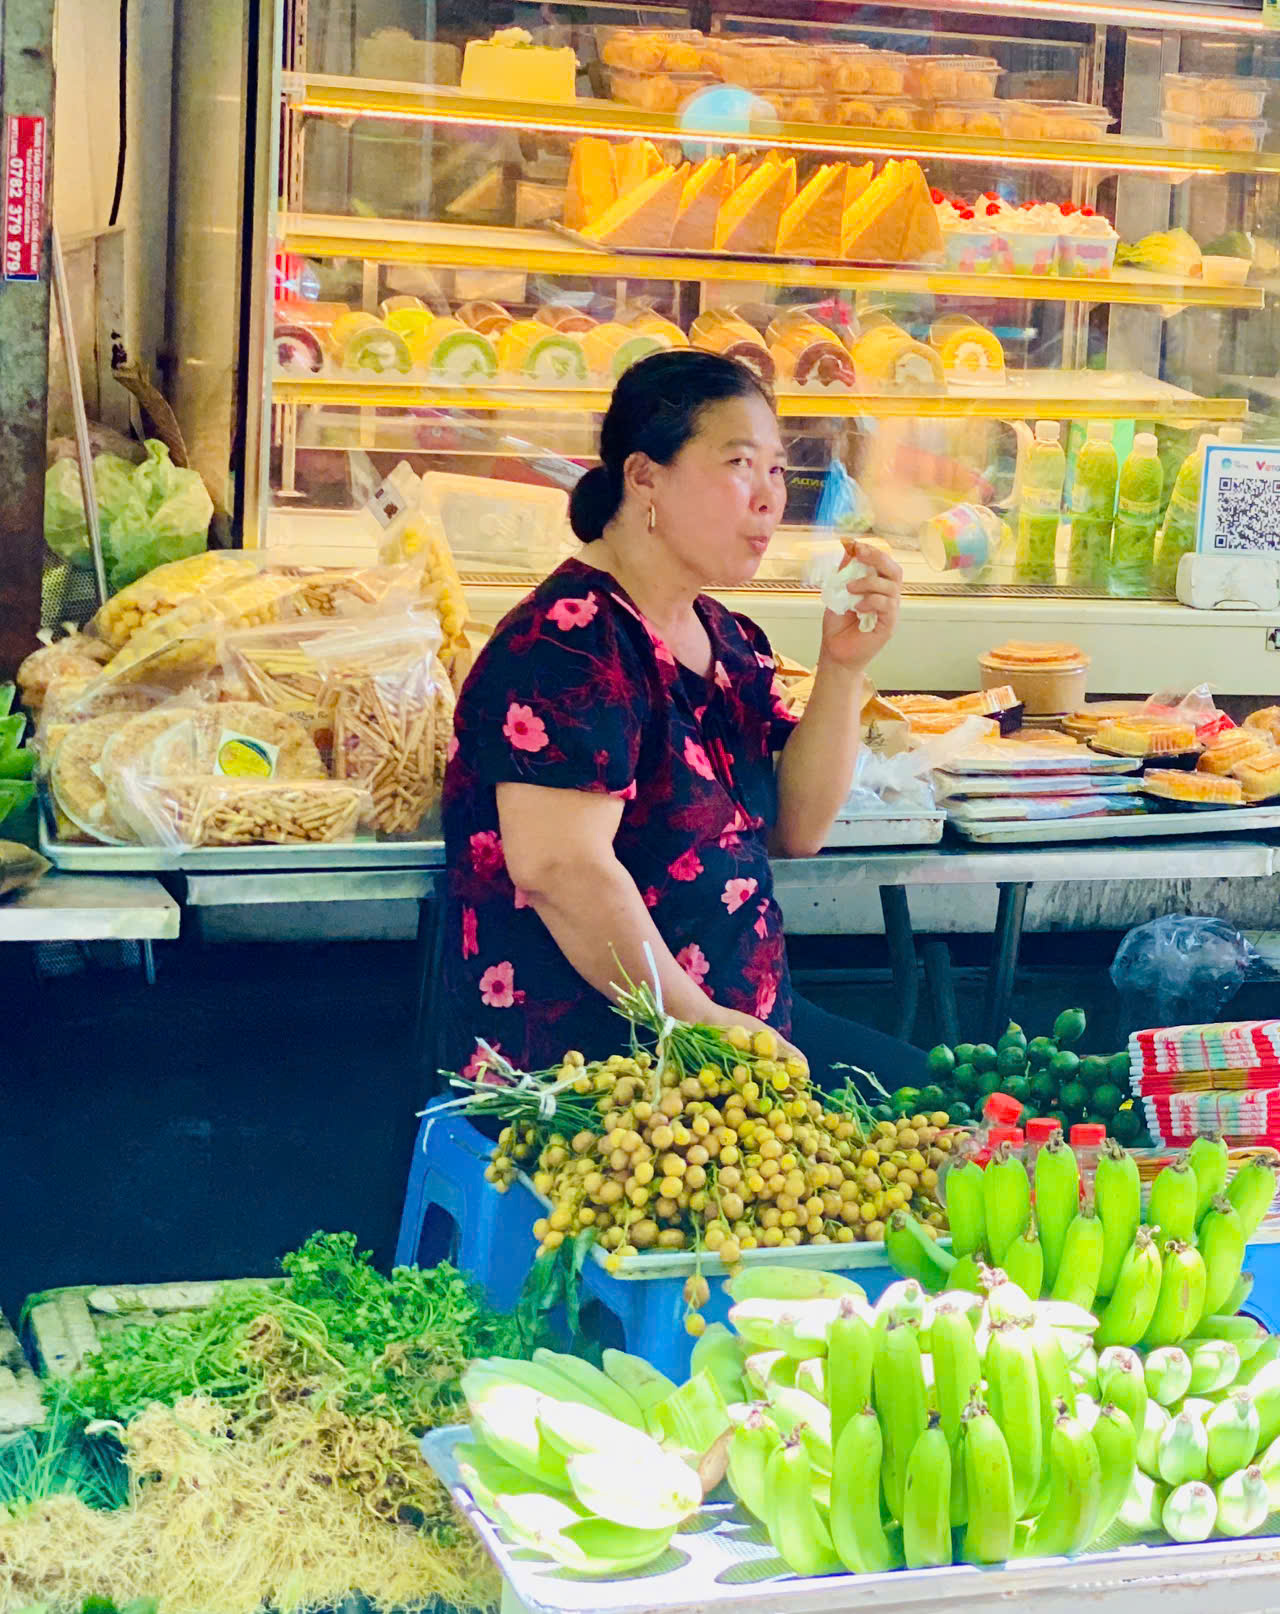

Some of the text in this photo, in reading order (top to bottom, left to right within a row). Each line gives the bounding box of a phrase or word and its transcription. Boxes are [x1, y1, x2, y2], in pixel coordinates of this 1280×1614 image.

[9, 157, 24, 199] 0782
[8, 203, 23, 236] 379
[7, 240, 21, 272] 979
